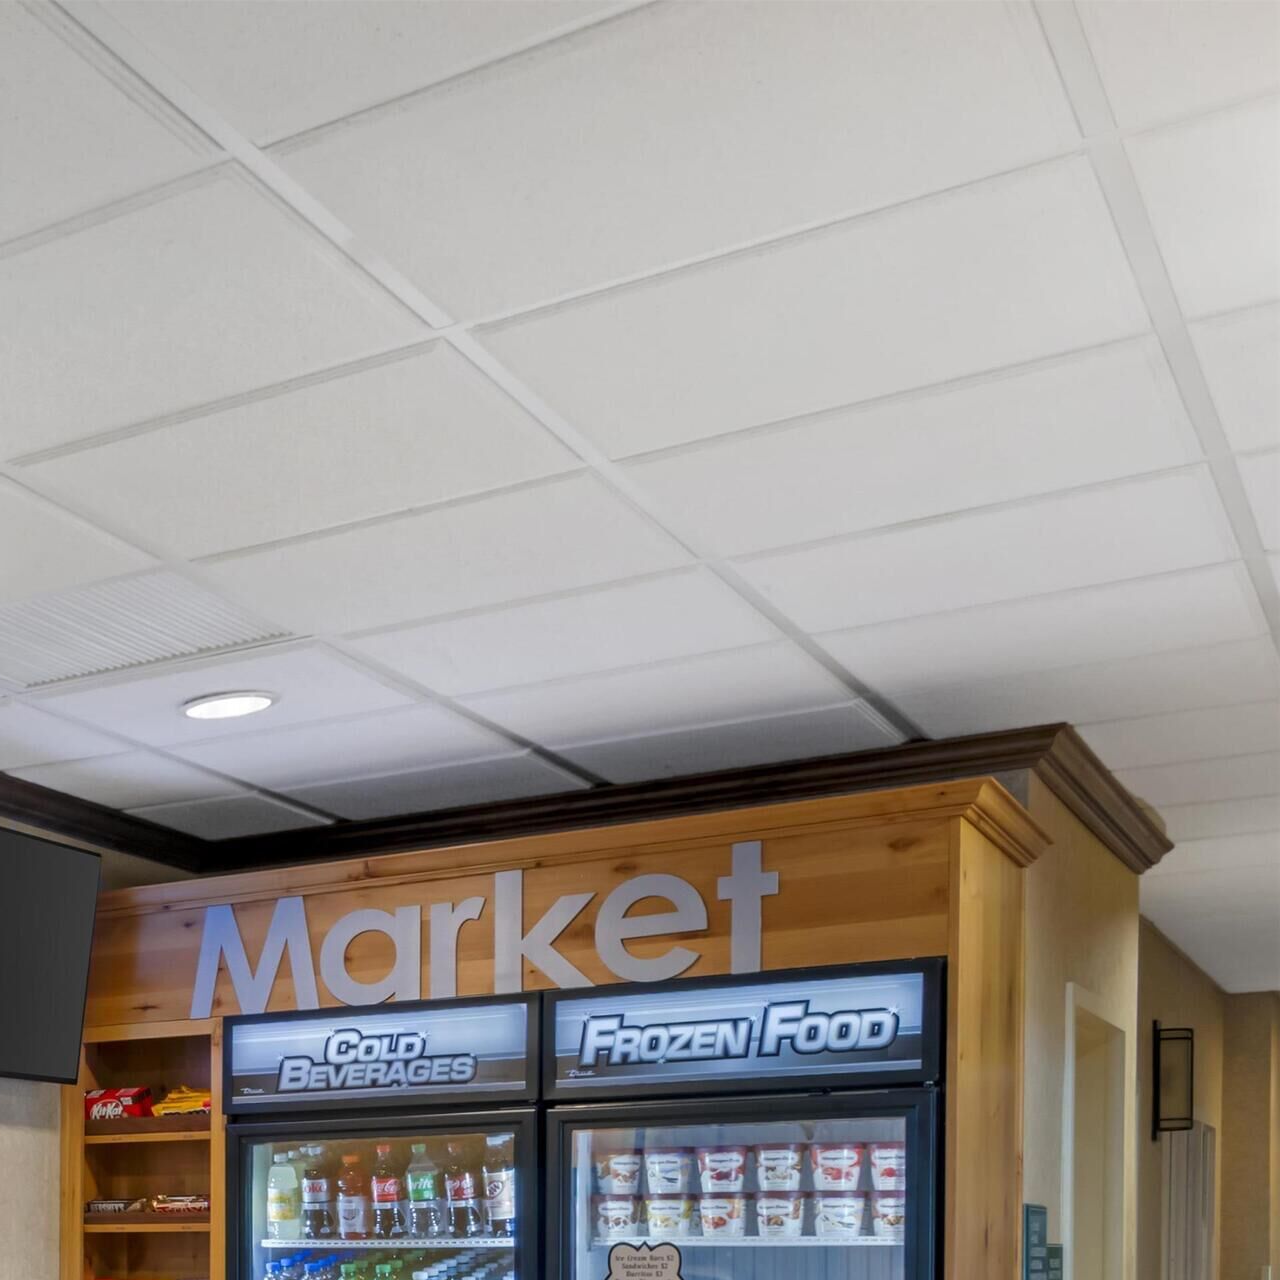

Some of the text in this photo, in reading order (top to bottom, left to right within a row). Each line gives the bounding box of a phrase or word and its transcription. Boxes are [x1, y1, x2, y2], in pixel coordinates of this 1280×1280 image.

[189, 840, 779, 1019] Market
[326, 1029, 424, 1063] COLD
[580, 1003, 898, 1067] FROZEN FOOD
[278, 1055, 476, 1091] BEVERAGES
